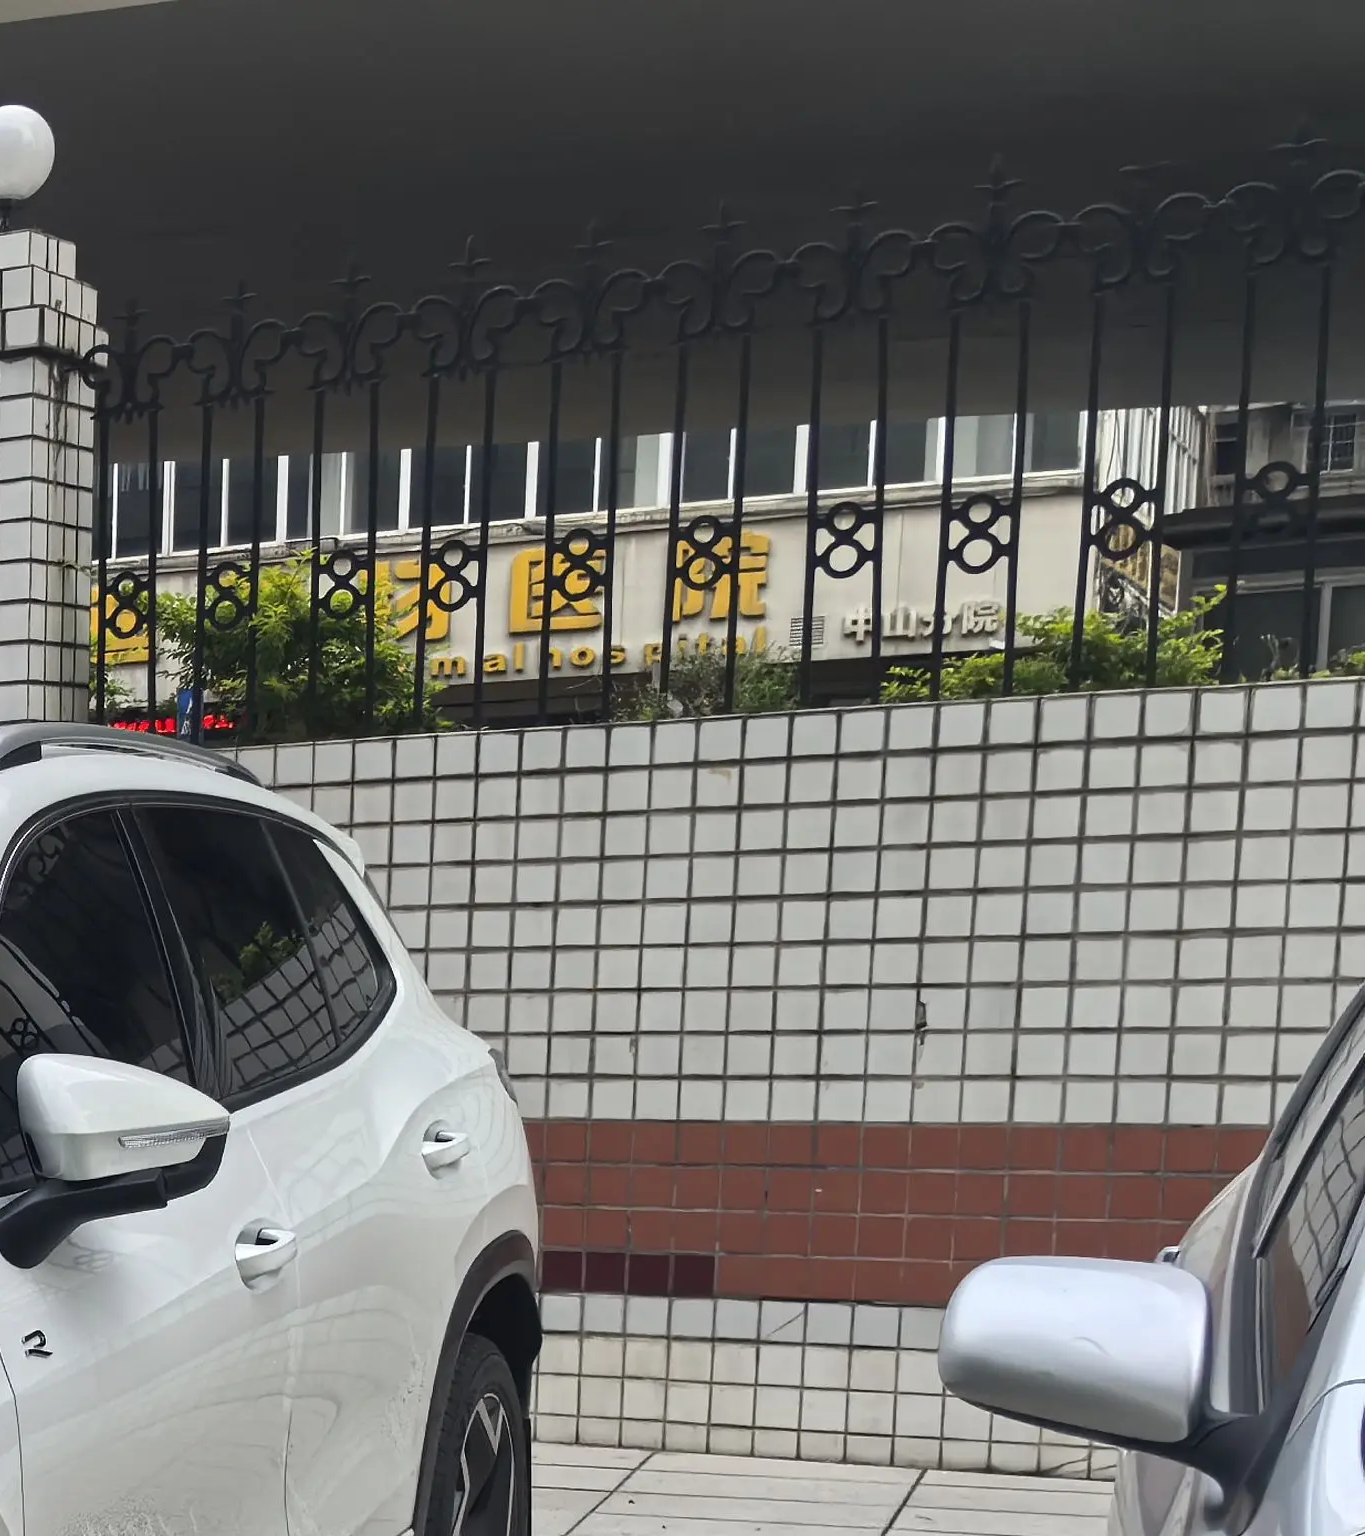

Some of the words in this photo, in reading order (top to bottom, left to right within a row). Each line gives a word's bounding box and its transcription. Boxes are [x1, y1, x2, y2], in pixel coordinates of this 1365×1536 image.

[842, 600, 1001, 644] 中山分院
[431, 641, 526, 677] mal
